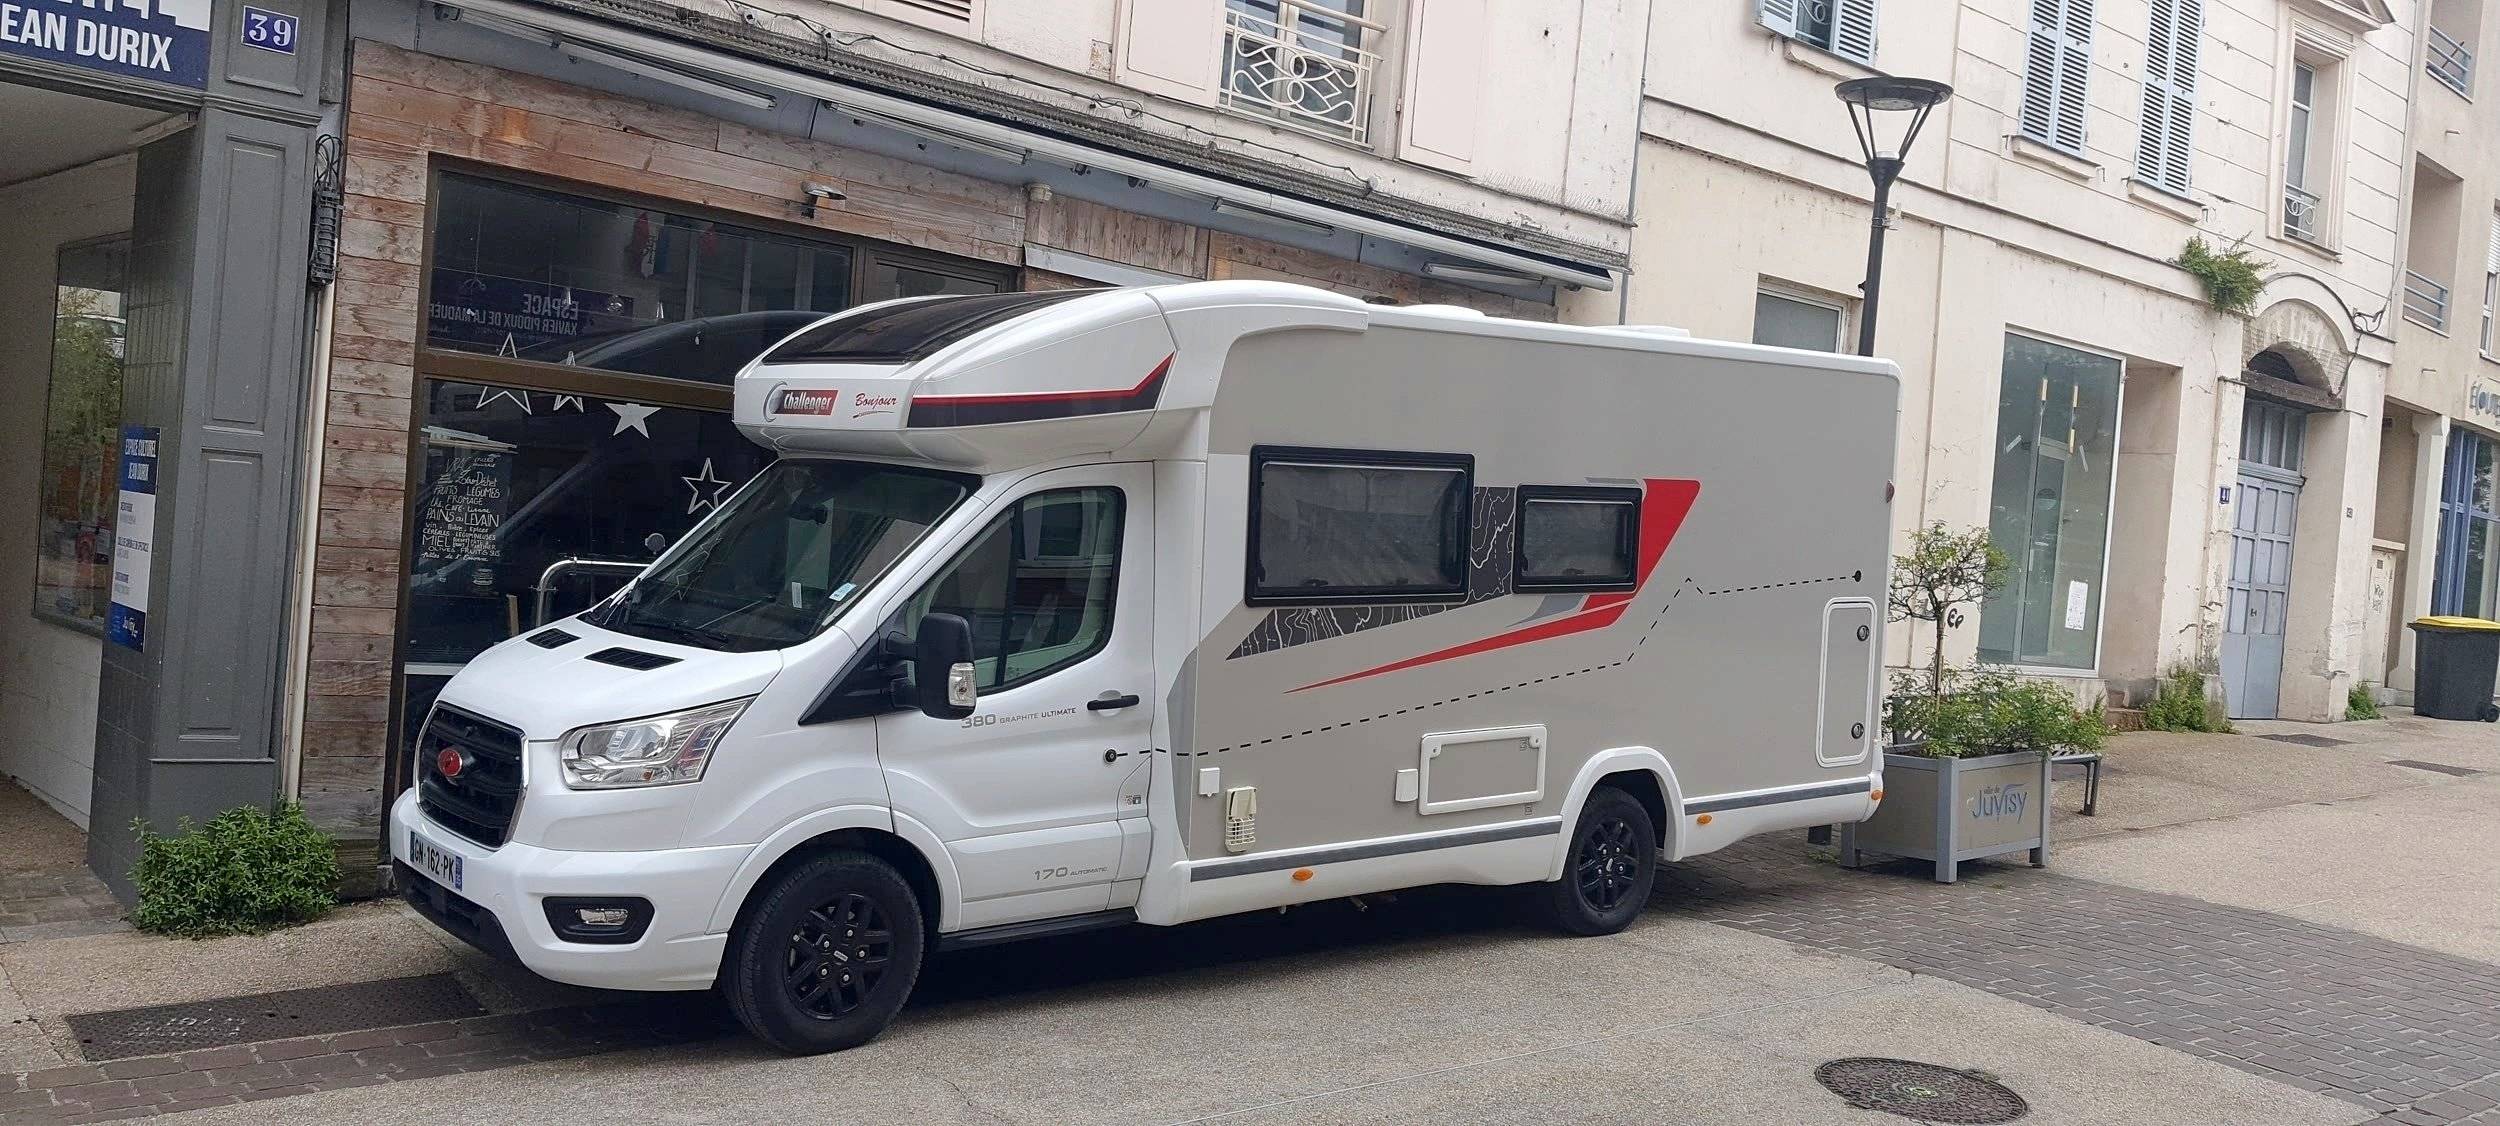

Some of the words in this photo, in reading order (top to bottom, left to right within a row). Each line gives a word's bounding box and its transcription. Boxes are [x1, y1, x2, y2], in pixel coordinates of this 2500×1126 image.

[249, 13, 292, 47] 39
[76, 18, 173, 72] DURIX
[783, 391, 833, 415] Challenger
[855, 392, 898, 410] Bonjour
[447, 495, 483, 506] FROMAGE
[426, 507, 454, 522] PAINS
[464, 512, 500, 527] LEVAIN
[421, 534, 450, 547] MIEL
[961, 713, 996, 729] 380
[1000, 712, 1039, 724] GRAPHITE
[1041, 707, 1077, 719] ULTIMATE
[1034, 866, 1067, 880] 170
